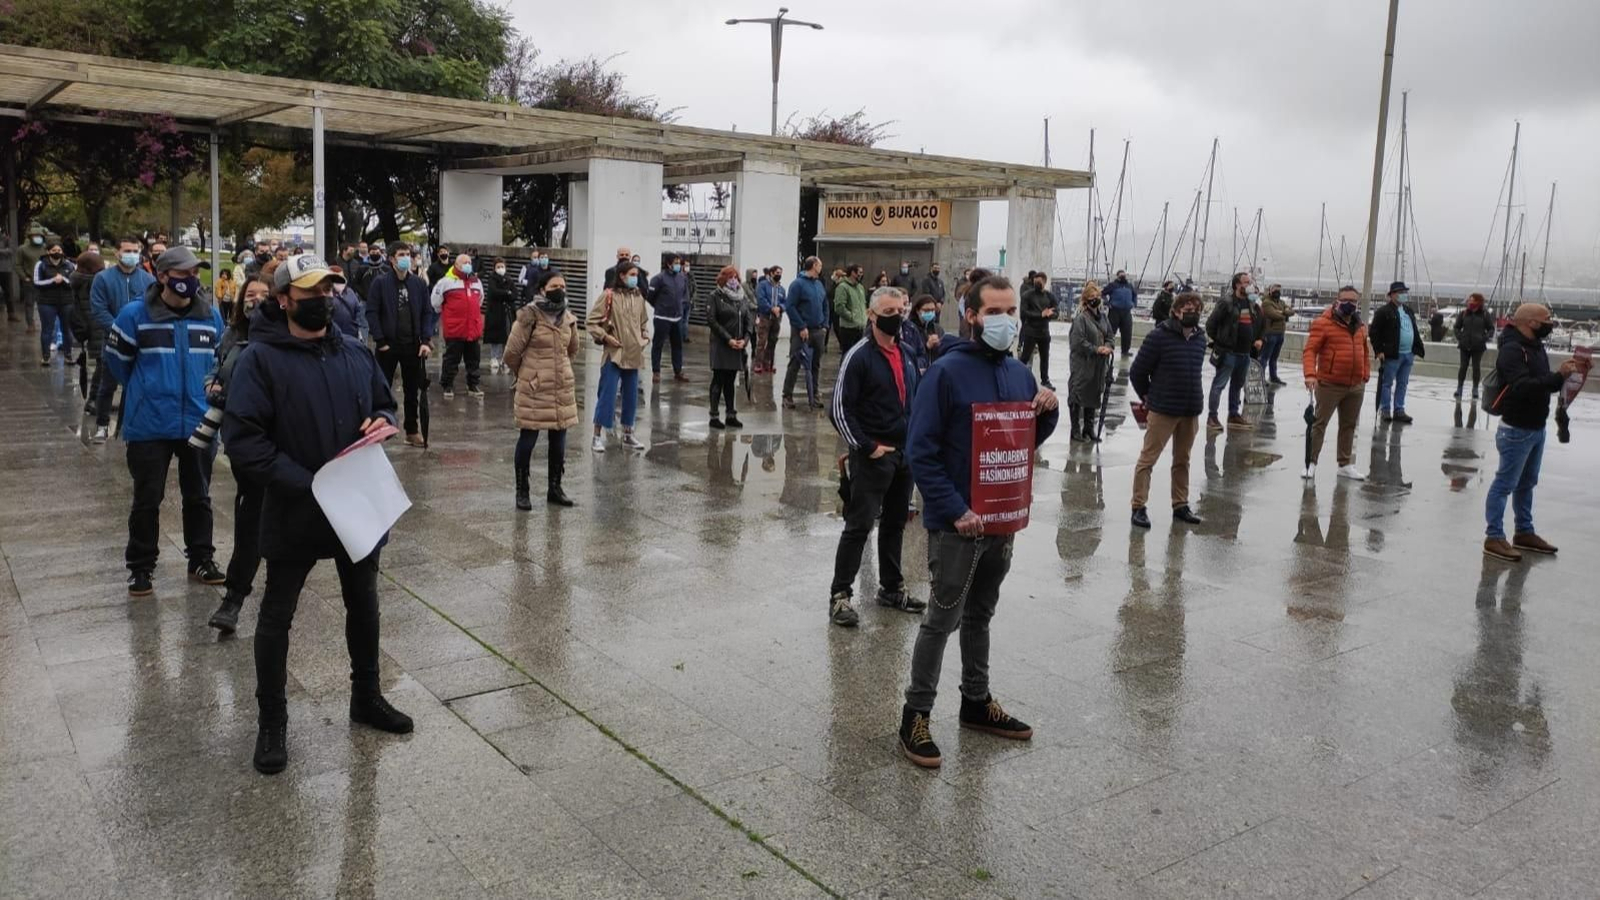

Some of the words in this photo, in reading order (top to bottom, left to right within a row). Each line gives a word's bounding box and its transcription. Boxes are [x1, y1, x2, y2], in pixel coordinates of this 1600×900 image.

[828, 206, 868, 219] KIOSKO
[888, 205, 938, 219] BURACO
[912, 220, 938, 230] VIGO
